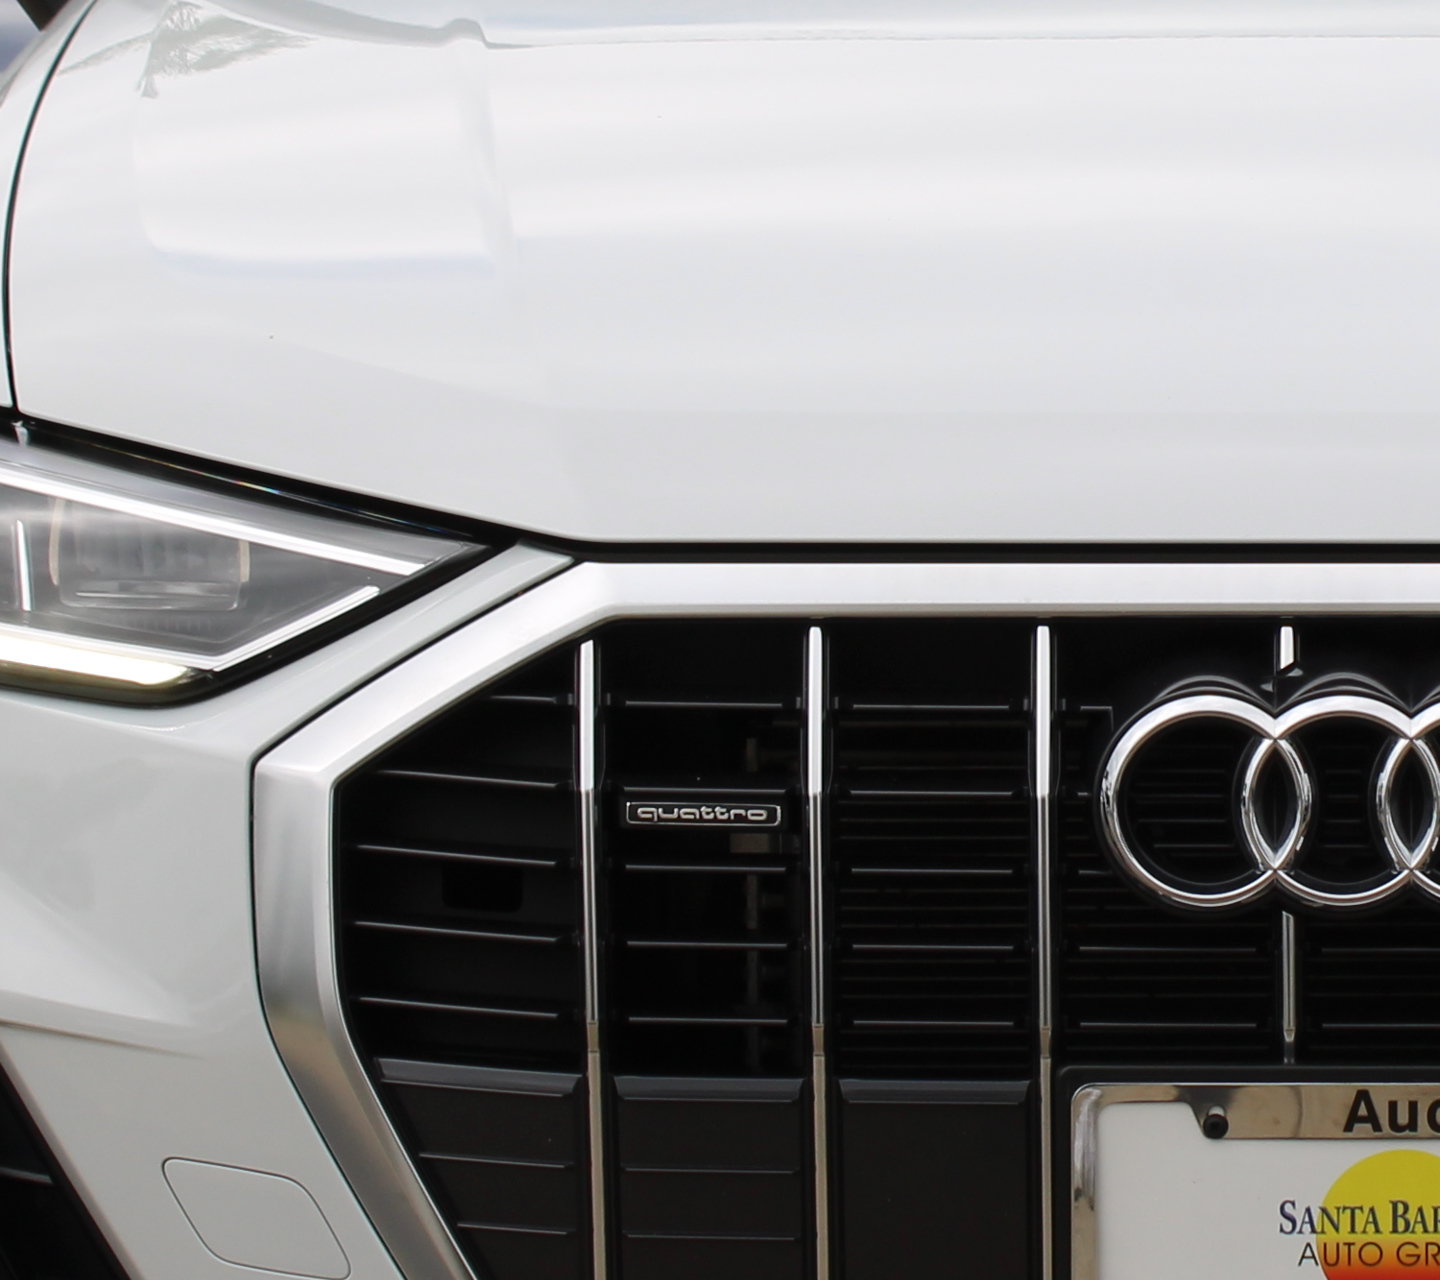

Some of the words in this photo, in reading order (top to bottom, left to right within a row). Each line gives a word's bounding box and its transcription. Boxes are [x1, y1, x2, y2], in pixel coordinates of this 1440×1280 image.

[637, 806, 768, 822] quattro
[1279, 1199, 1383, 1235] SANTA
[1298, 1241, 1384, 1267] AUTO
